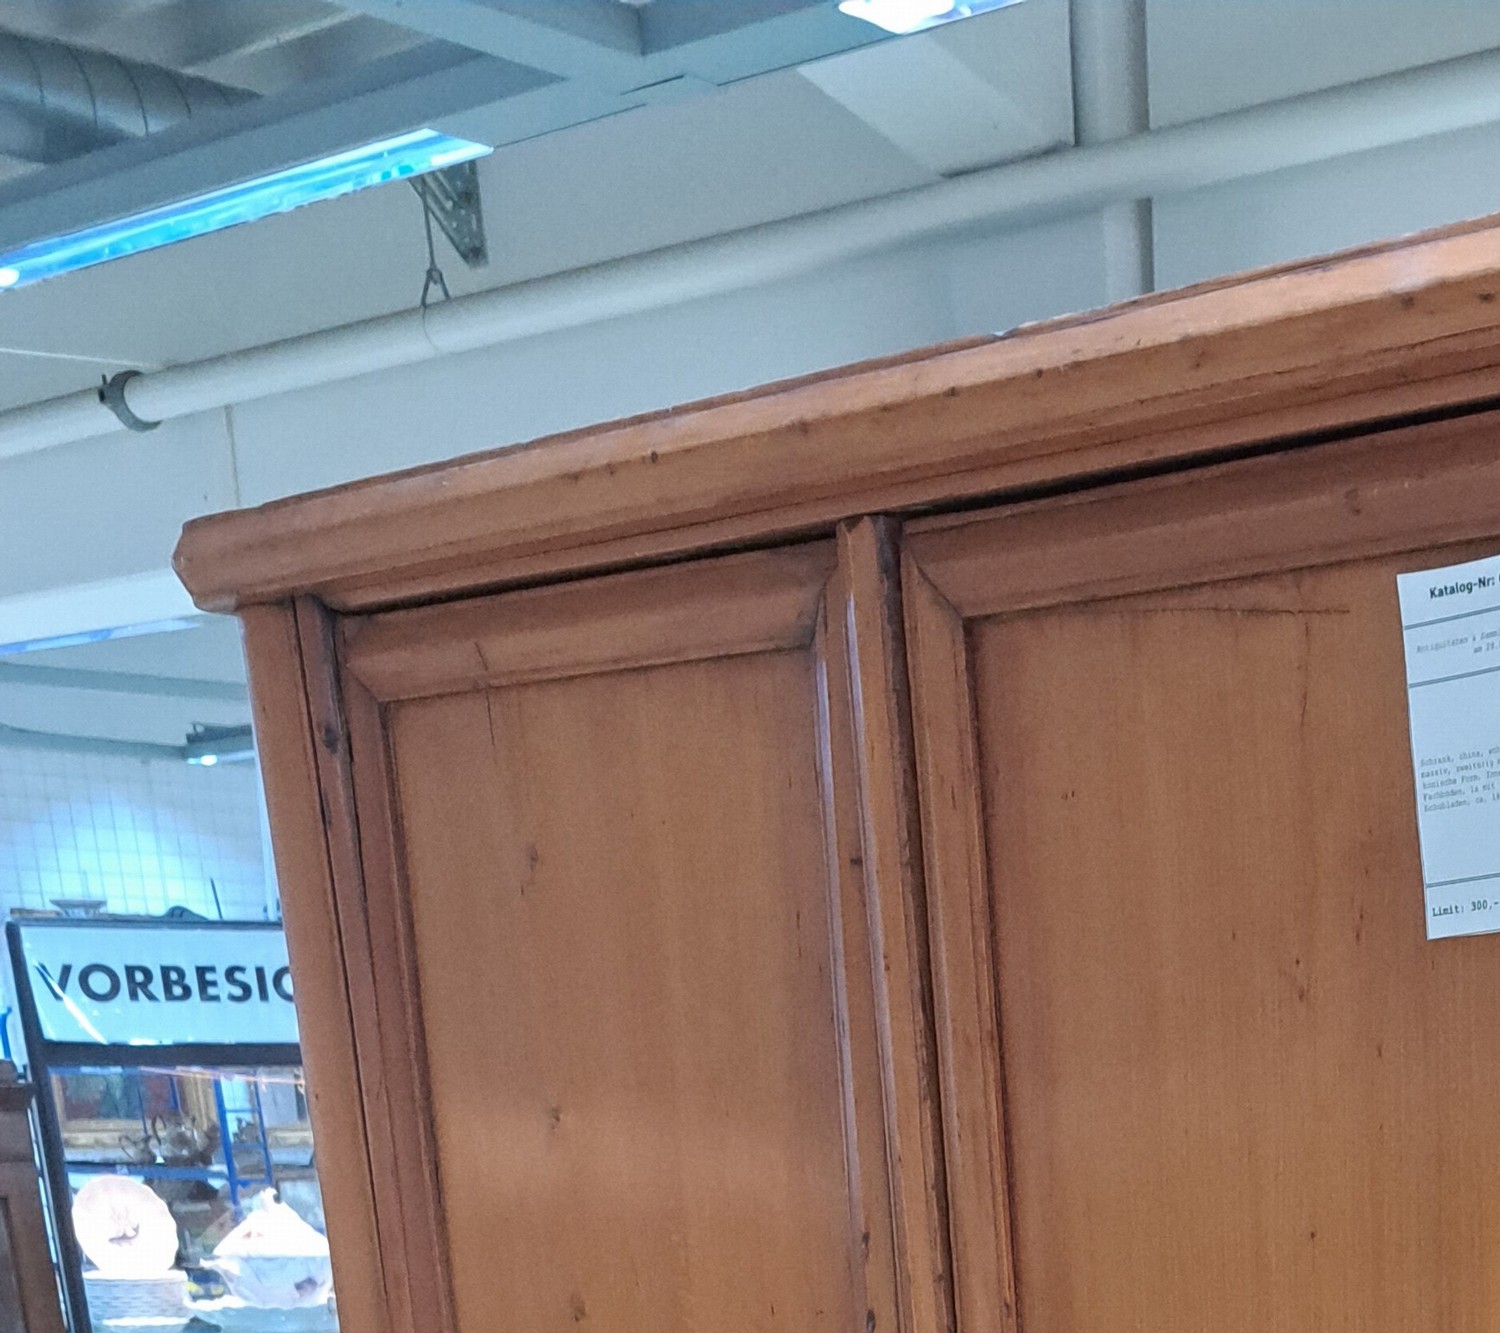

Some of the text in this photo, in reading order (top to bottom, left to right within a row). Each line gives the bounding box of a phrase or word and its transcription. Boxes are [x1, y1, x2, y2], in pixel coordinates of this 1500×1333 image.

[1429, 576, 1495, 599] Katalog-Nr:
[1432, 904, 1464, 917] Limit:
[1471, 899, 1500, 912] 300,-
